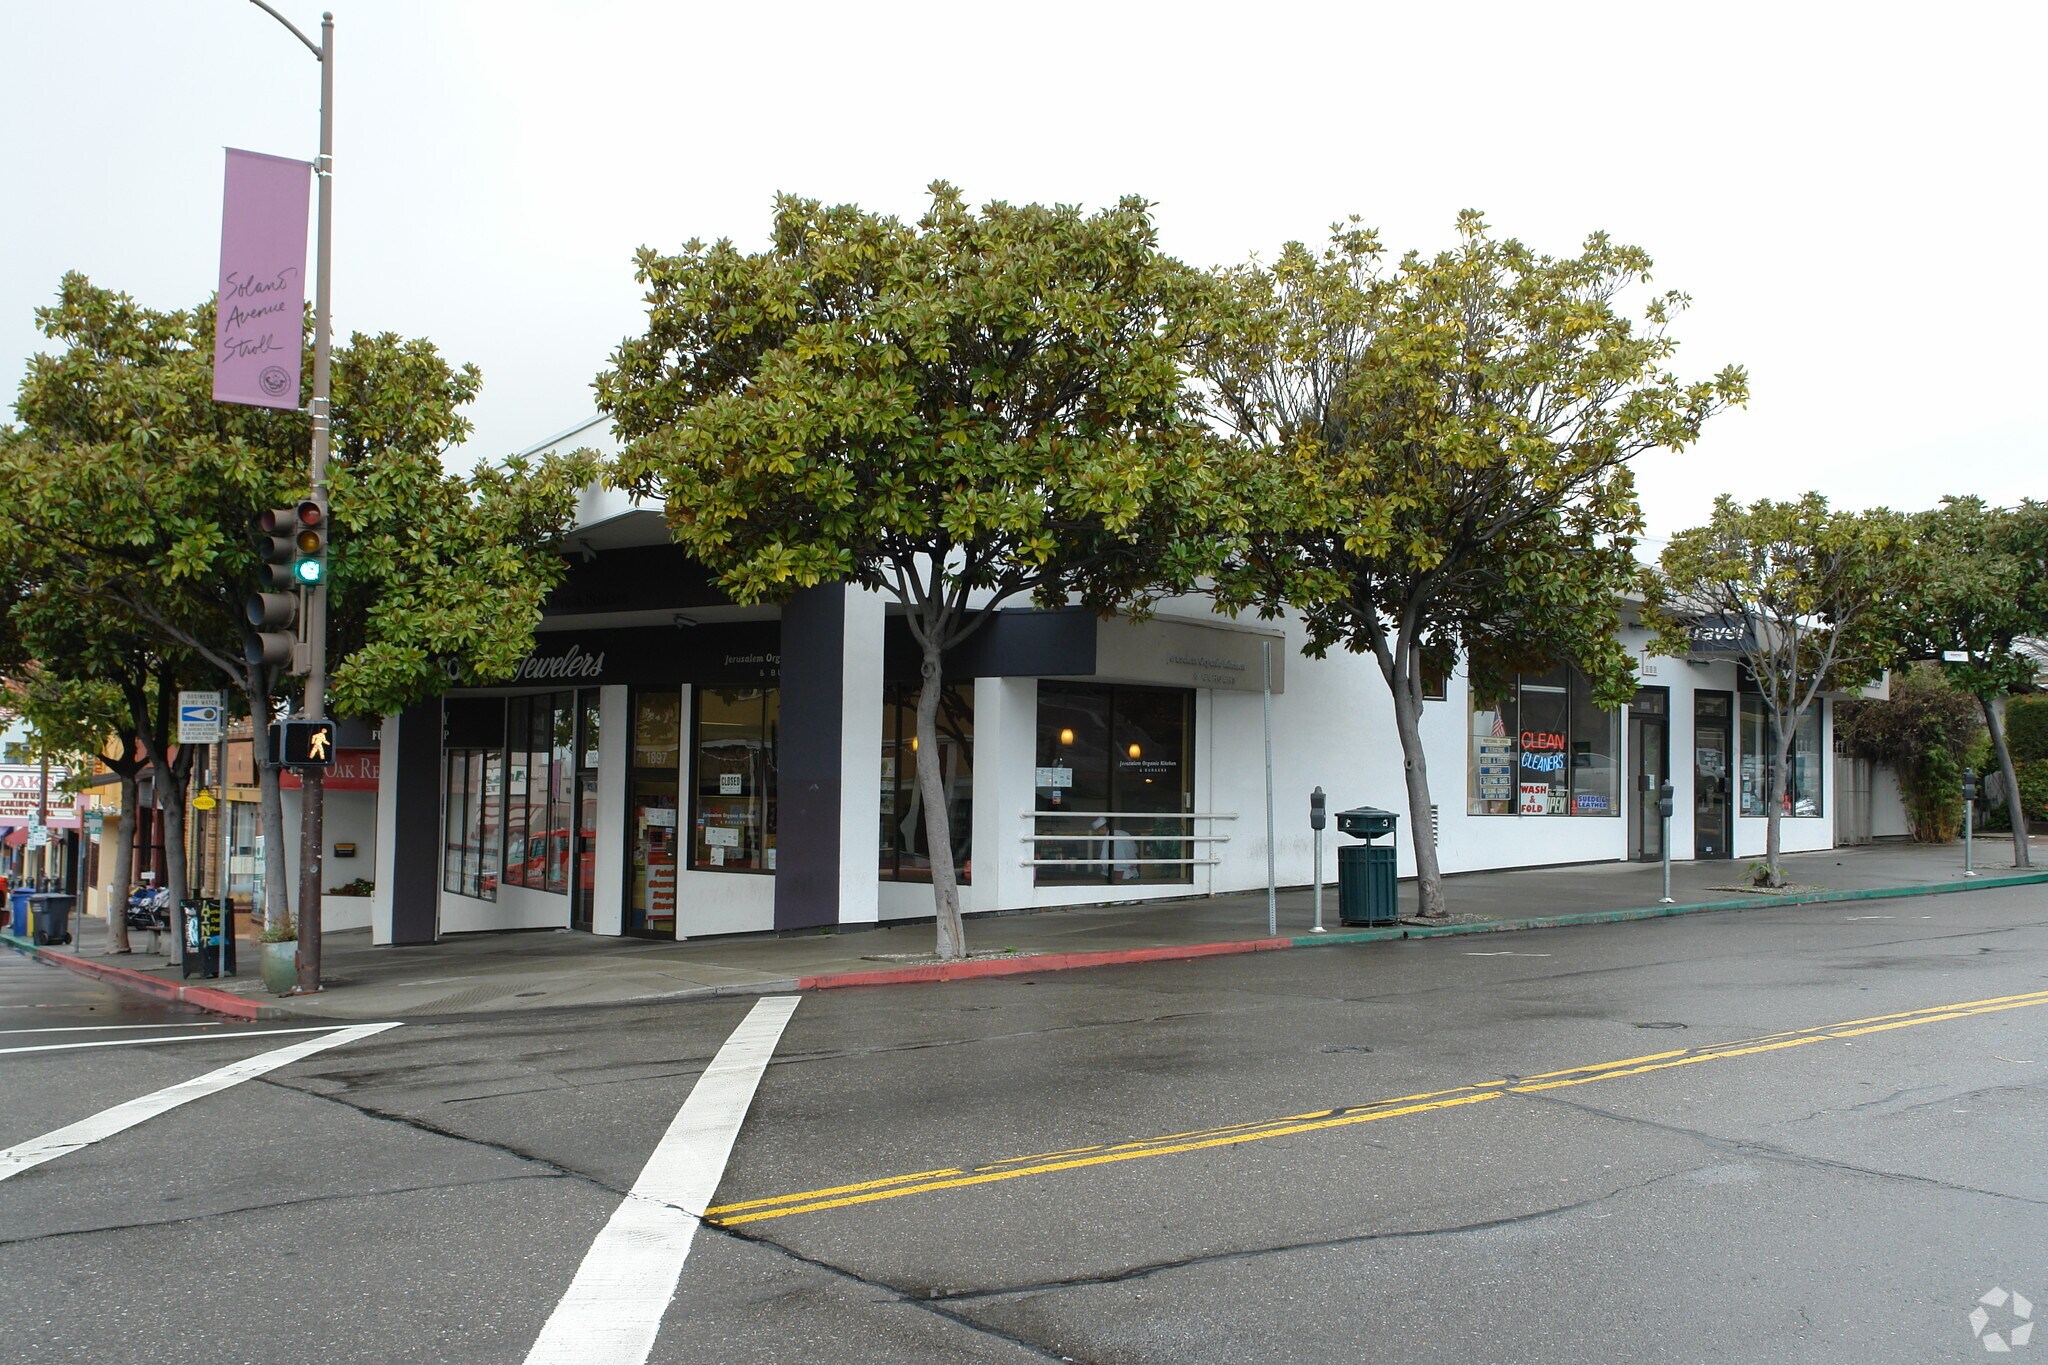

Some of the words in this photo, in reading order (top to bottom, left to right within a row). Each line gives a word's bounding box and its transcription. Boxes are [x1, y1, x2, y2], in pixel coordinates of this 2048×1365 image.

[224, 267, 297, 300] Solano
[224, 302, 286, 333] Avenue
[222, 333, 284, 363] Stroll
[1692, 622, 1746, 641] ravel
[724, 653, 764, 666] Jerusalem
[1520, 731, 1565, 750] CLEAN
[646, 751, 668, 765] 1897
[1520, 751, 1565, 772] CLEANERS
[721, 776, 741, 786] CLOSED
[1520, 785, 1547, 794] WASH
[1529, 795, 1536, 803] &
[1578, 795, 1600, 803] SUEDE
[1520, 804, 1543, 813] FOLD
